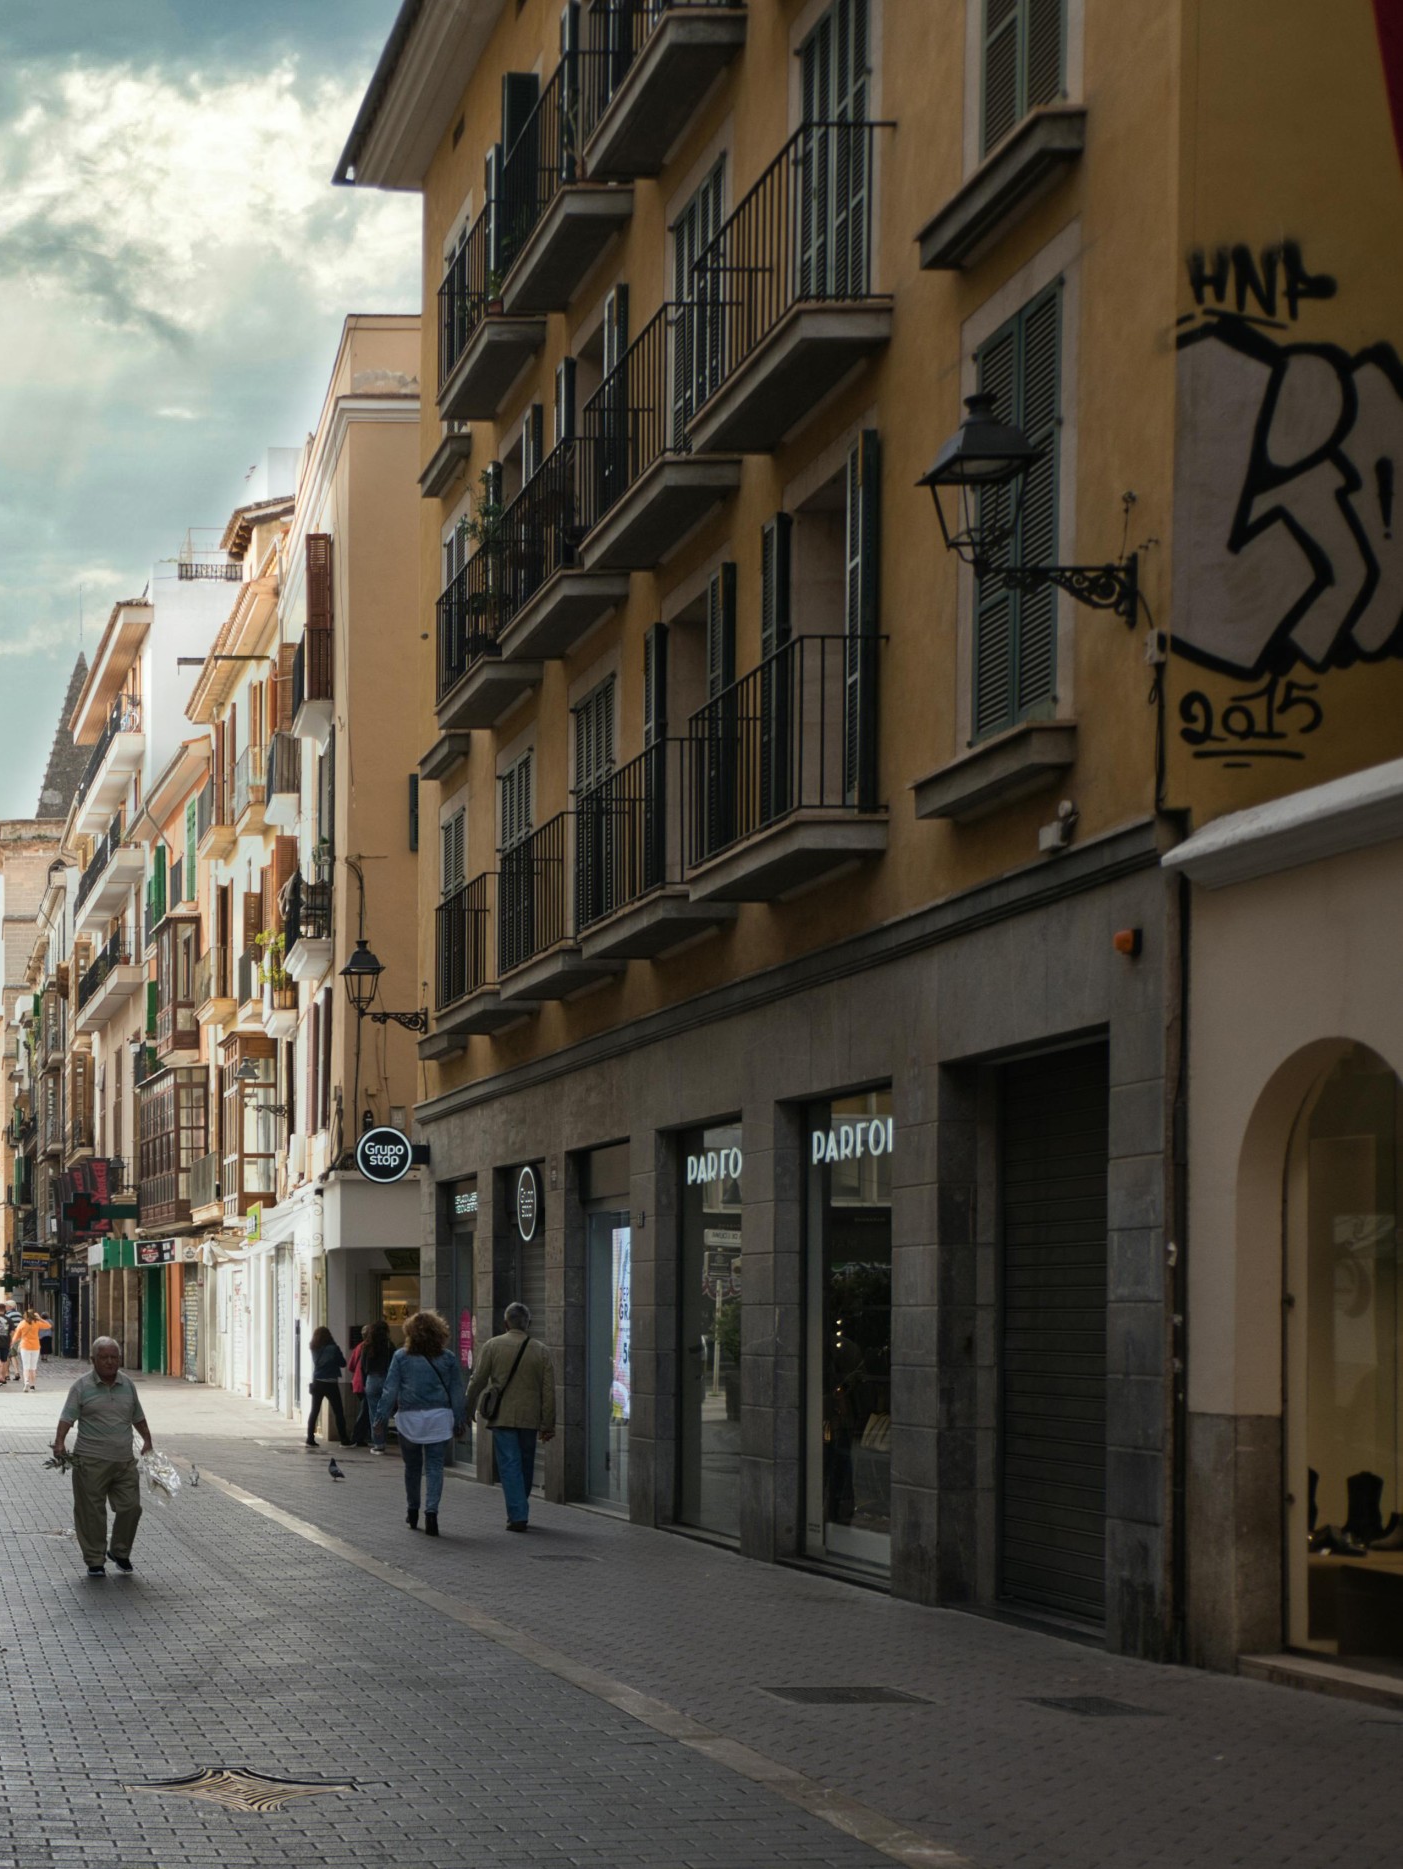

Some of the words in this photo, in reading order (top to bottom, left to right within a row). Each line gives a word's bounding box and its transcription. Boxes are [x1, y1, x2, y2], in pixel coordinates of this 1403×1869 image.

[1178, 674, 1324, 745] 2015
[364, 1142, 405, 1156] Grupo
[369, 1155, 400, 1168] stop
